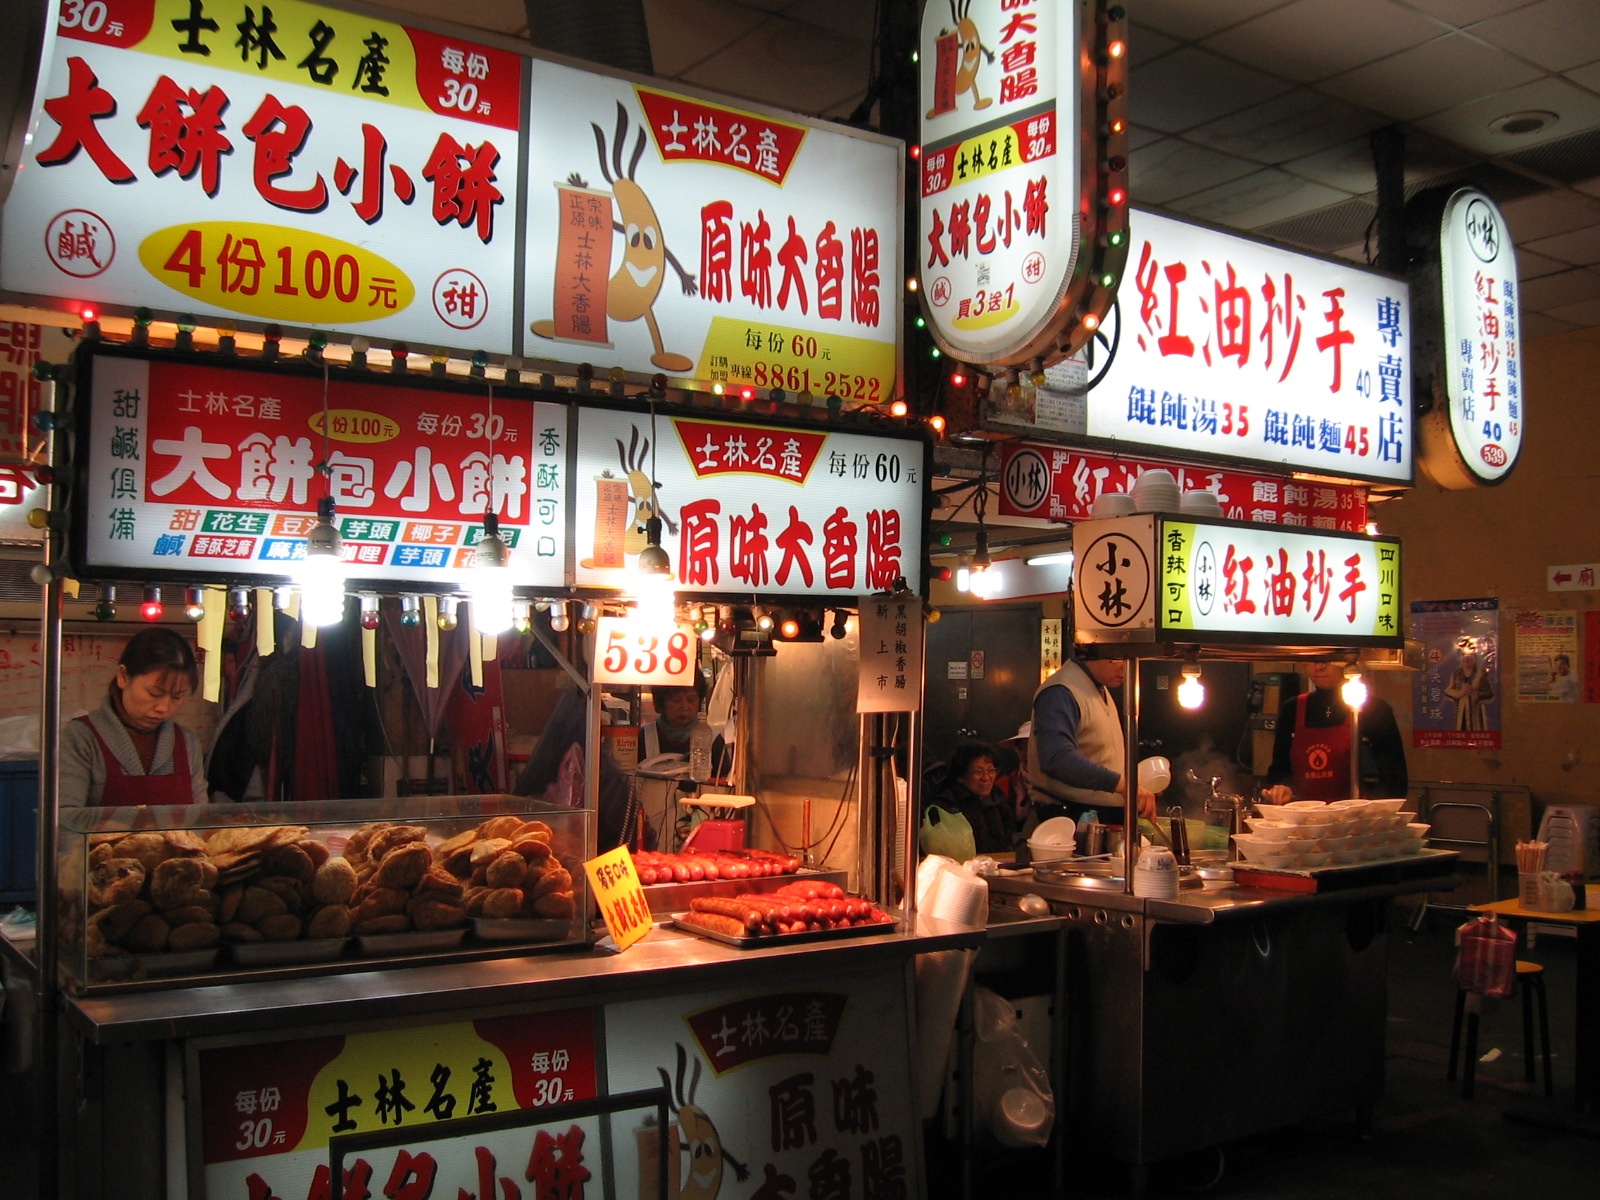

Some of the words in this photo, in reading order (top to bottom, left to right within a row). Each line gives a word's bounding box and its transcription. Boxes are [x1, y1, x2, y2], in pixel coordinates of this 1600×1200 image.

[171, 0, 392, 98] 士林名產
[440, 46, 490, 81] 每份
[1000, 0, 1038, 105] 大香腸
[438, 78, 492, 116] 30元
[35, 56, 507, 245] 大餅包小餅
[661, 109, 781, 177] 士林名產
[1026, 137, 1052, 161] 30元
[1027, 116, 1051, 137] 每份
[926, 153, 946, 171] 每份
[957, 134, 1012, 179] 士林名產
[569, 195, 602, 214] 正宗
[926, 173, 947, 193] 30元
[57, 221, 102, 270] 鹹
[927, 174, 1049, 270] 大餅包小餅
[1468, 212, 1497, 255] 小林
[163, 229, 398, 310] 4份100元
[571, 231, 596, 335] 士林大香腸
[699, 199, 881, 328] 原味大香腸
[1025, 257, 1042, 279] 甜
[442, 281, 479, 316] 甜
[956, 281, 1016, 321] 買3送1
[1134, 240, 1356, 395] 紅油抄手
[1474, 270, 1501, 412] 紅油抄手
[1355, 368, 1371, 398] 40
[1374, 296, 1403, 464] 專賣店
[1461, 338, 1475, 422] 專賣店
[177, 388, 282, 421] 士林名產
[1482, 420, 1502, 441] 40
[109, 388, 141, 541] 甜鹹俱備
[149, 424, 529, 520] 大餅包小餅
[695, 433, 803, 477] 士林名產
[1484, 446, 1504, 465] 539
[535, 426, 562, 559] 香酥可口
[1008, 464, 1046, 500] 小林
[169, 508, 201, 532] 甜
[210, 513, 261, 533] 花生
[346, 520, 394, 541] 芋頭
[411, 524, 454, 543] 椰子
[678, 498, 902, 591] 原味大香腸
[153, 534, 187, 557] 鹹
[193, 536, 253, 558] 香酥芝麻
[399, 548, 444, 567] 芋頭
[1096, 541, 1131, 619] 小林
[1166, 529, 1186, 625] 香辣可口
[1198, 554, 1213, 602] 小林
[1222, 543, 1367, 623] 紅油抄手
[1378, 547, 1396, 632] 四川口味
[1578, 567, 1594, 587] 廁
[604, 630, 688, 675] 538
[876, 604, 888, 690] 新上市
[895, 604, 907, 689] 黑胡椒香腸
[711, 999, 829, 1057] 士林名產
[530, 1049, 570, 1075] 每份
[234, 1086, 282, 1115] 每份
[324, 1057, 498, 1133] 士林名產
[532, 1077, 575, 1107] 30元
[235, 1118, 286, 1151] 30元
[245, 1124, 592, 1200] 包小餅
